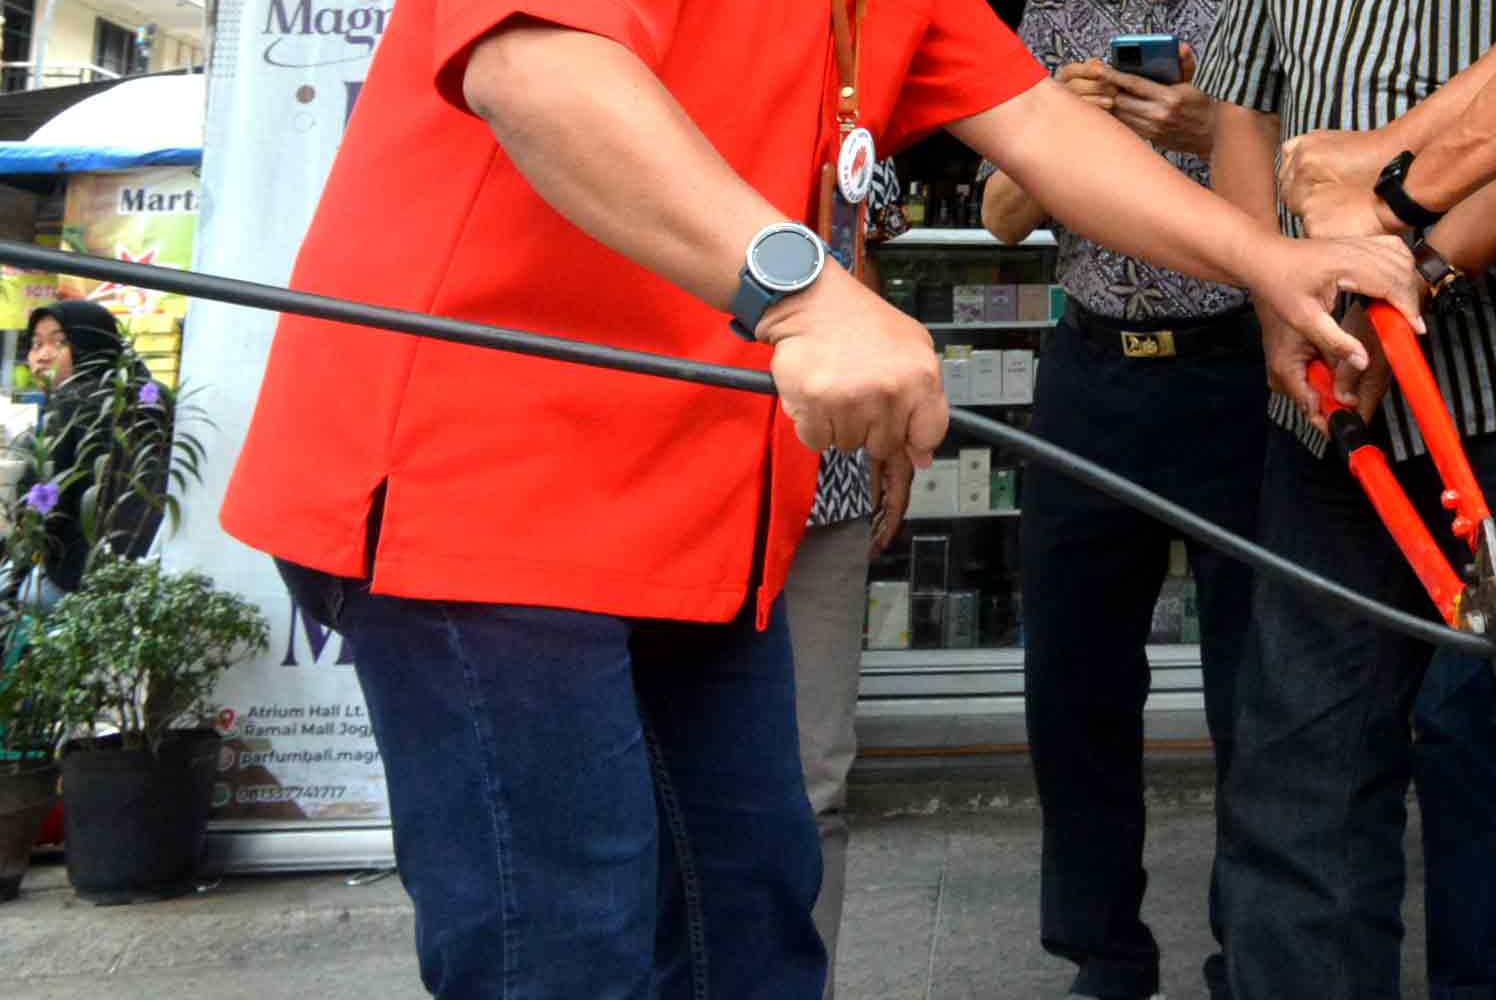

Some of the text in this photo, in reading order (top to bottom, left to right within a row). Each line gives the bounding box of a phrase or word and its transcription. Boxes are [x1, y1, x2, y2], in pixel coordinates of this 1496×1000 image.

[119, 187, 201, 213] Mart
[247, 704, 305, 719] Atrium
[308, 703, 342, 718] Hall
[300, 722, 336, 737] Mall
